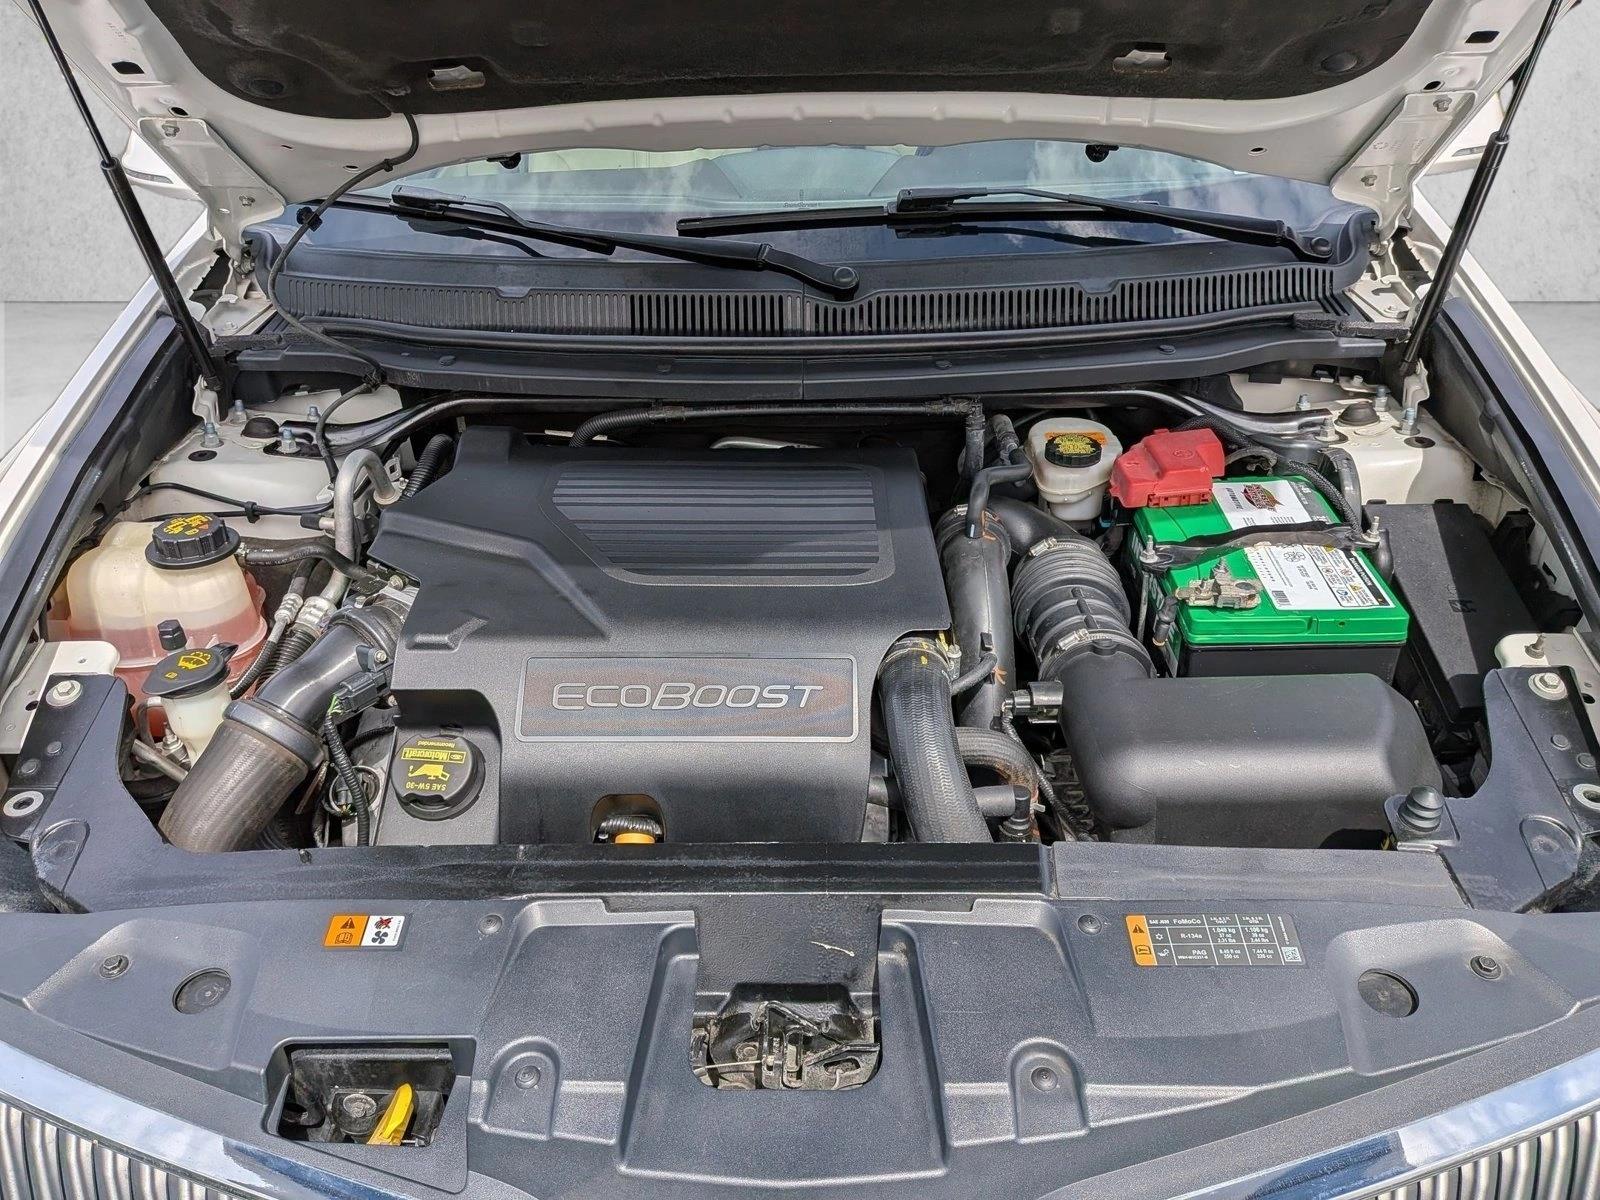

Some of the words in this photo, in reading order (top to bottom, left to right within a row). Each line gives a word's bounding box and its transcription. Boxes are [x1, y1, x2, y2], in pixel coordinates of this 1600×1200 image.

[417, 740, 456, 748] Recommended
[405, 748, 449, 760] Motorcraft
[405, 781, 430, 790] 5W-30
[431, 782, 447, 791] SAE
